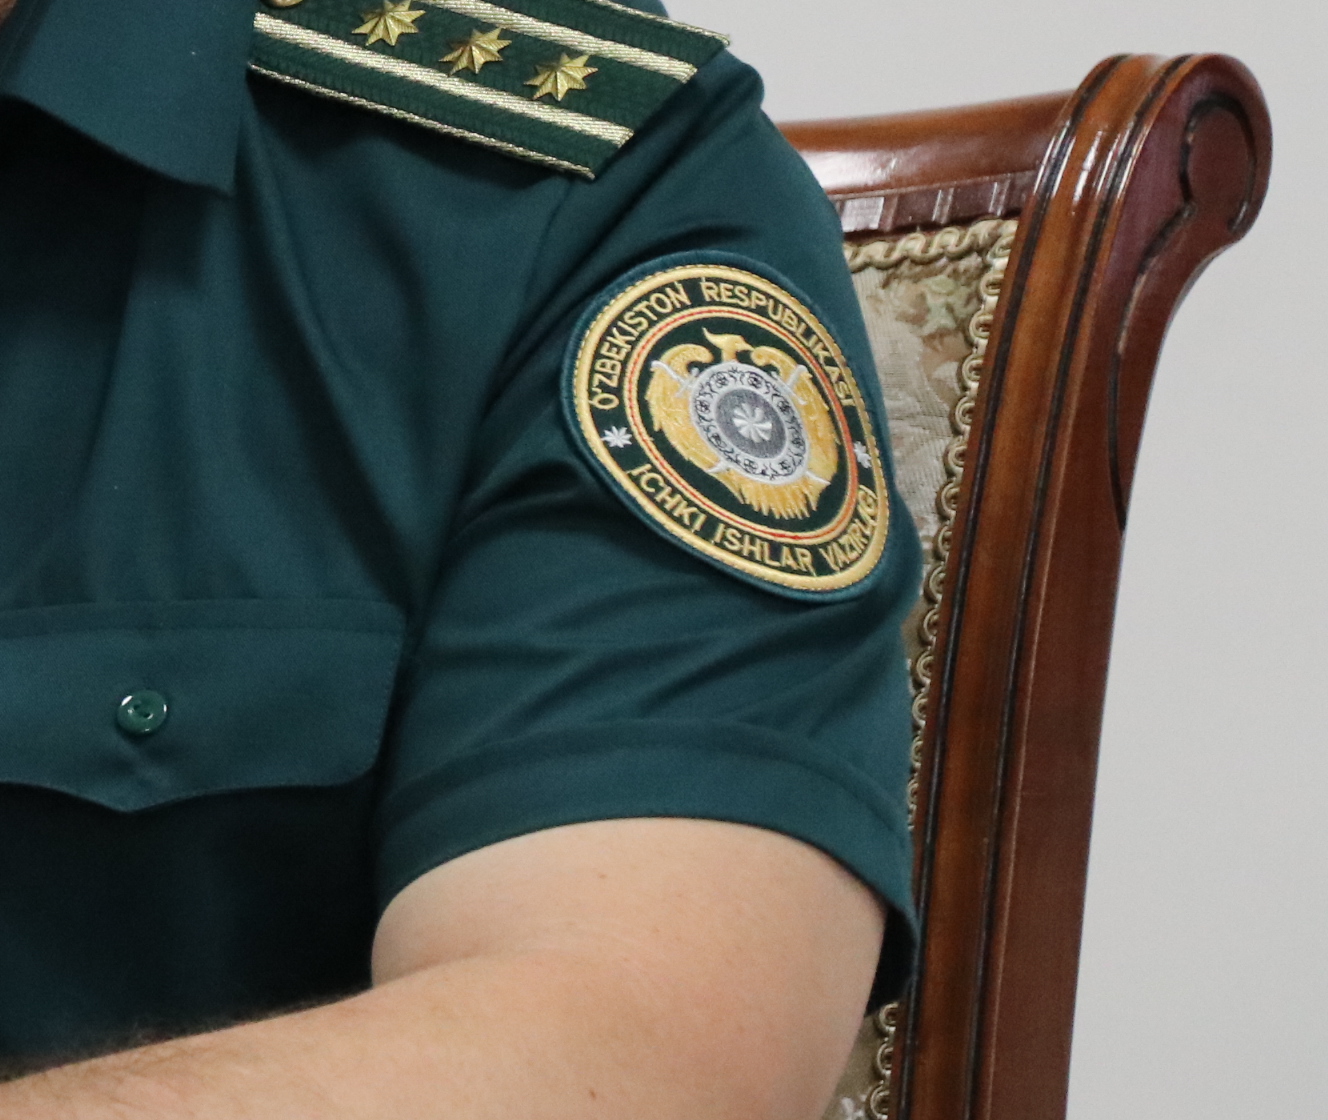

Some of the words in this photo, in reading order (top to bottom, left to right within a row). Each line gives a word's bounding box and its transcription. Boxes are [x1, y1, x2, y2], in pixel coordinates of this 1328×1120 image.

[700, 277, 857, 408] RESPUBLIKASI
[629, 463, 710, 535] ICHKI
[712, 522, 816, 577] ISHLAR
[819, 484, 879, 572] VAZIRLIGI
